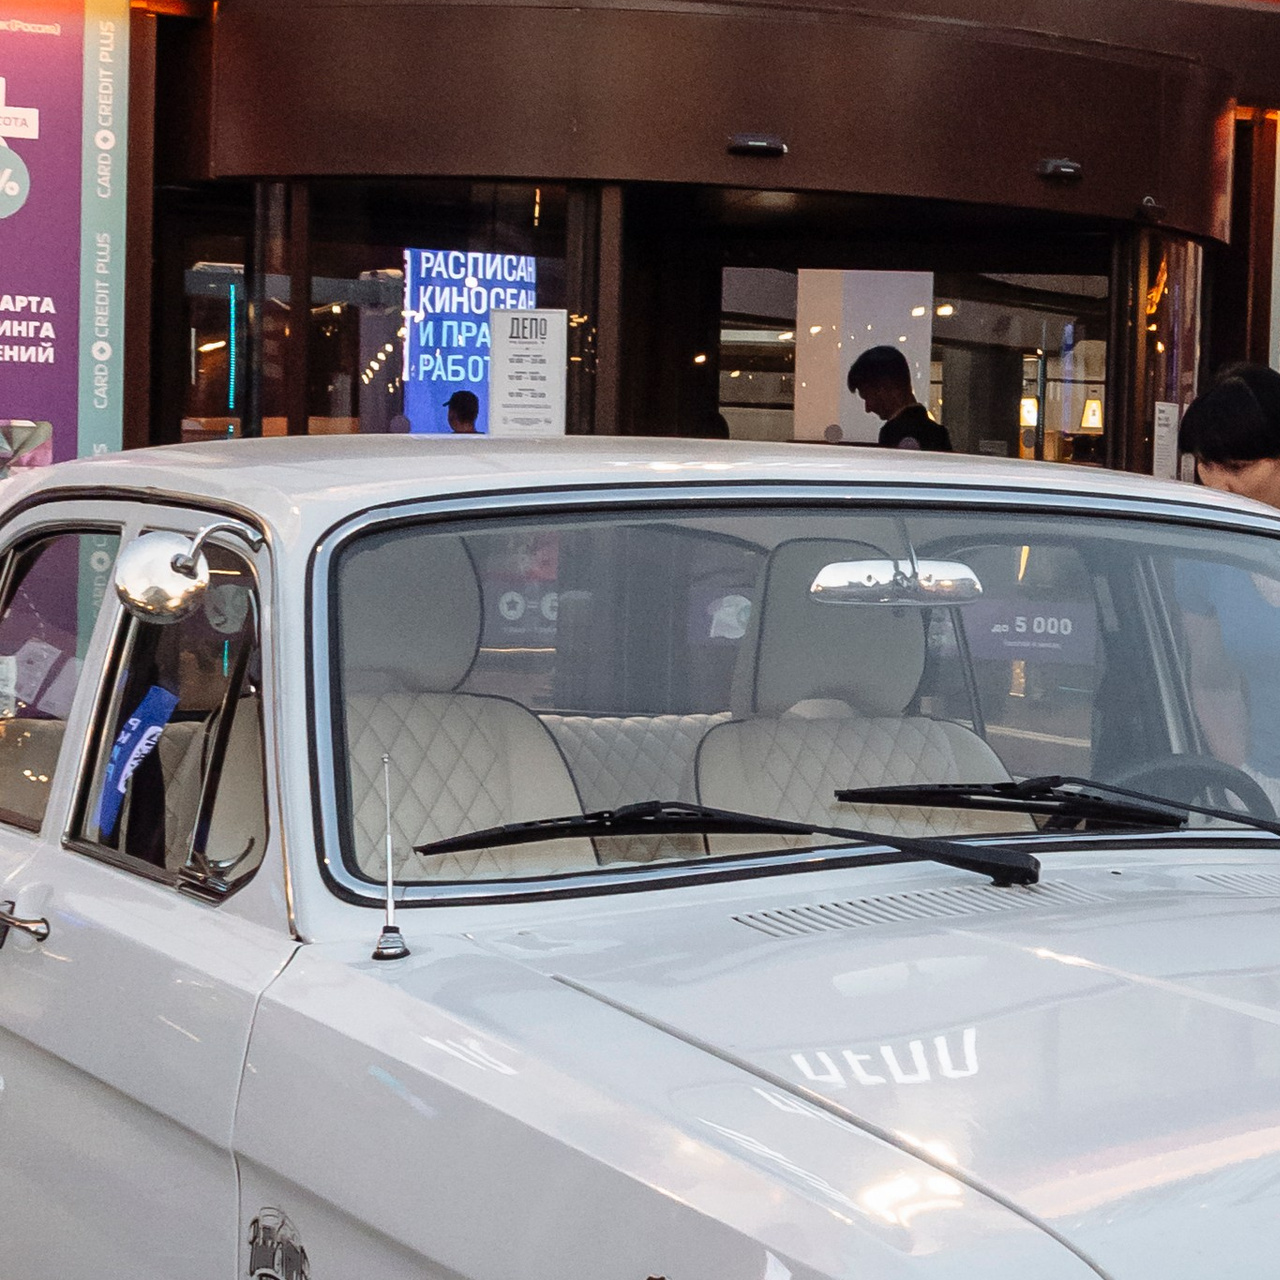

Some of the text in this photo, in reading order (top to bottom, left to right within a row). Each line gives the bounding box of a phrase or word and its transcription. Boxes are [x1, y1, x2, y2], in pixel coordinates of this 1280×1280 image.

[96, 20, 116, 199] CARD CREDIT PLUS
[93, 232, 111, 410] CARD CREDIT PLUS
[419, 320, 434, 347] И
[508, 317, 547, 339] ДЕПО
[1014, 616, 1027, 633] 5
[1032, 616, 1073, 635] 000
